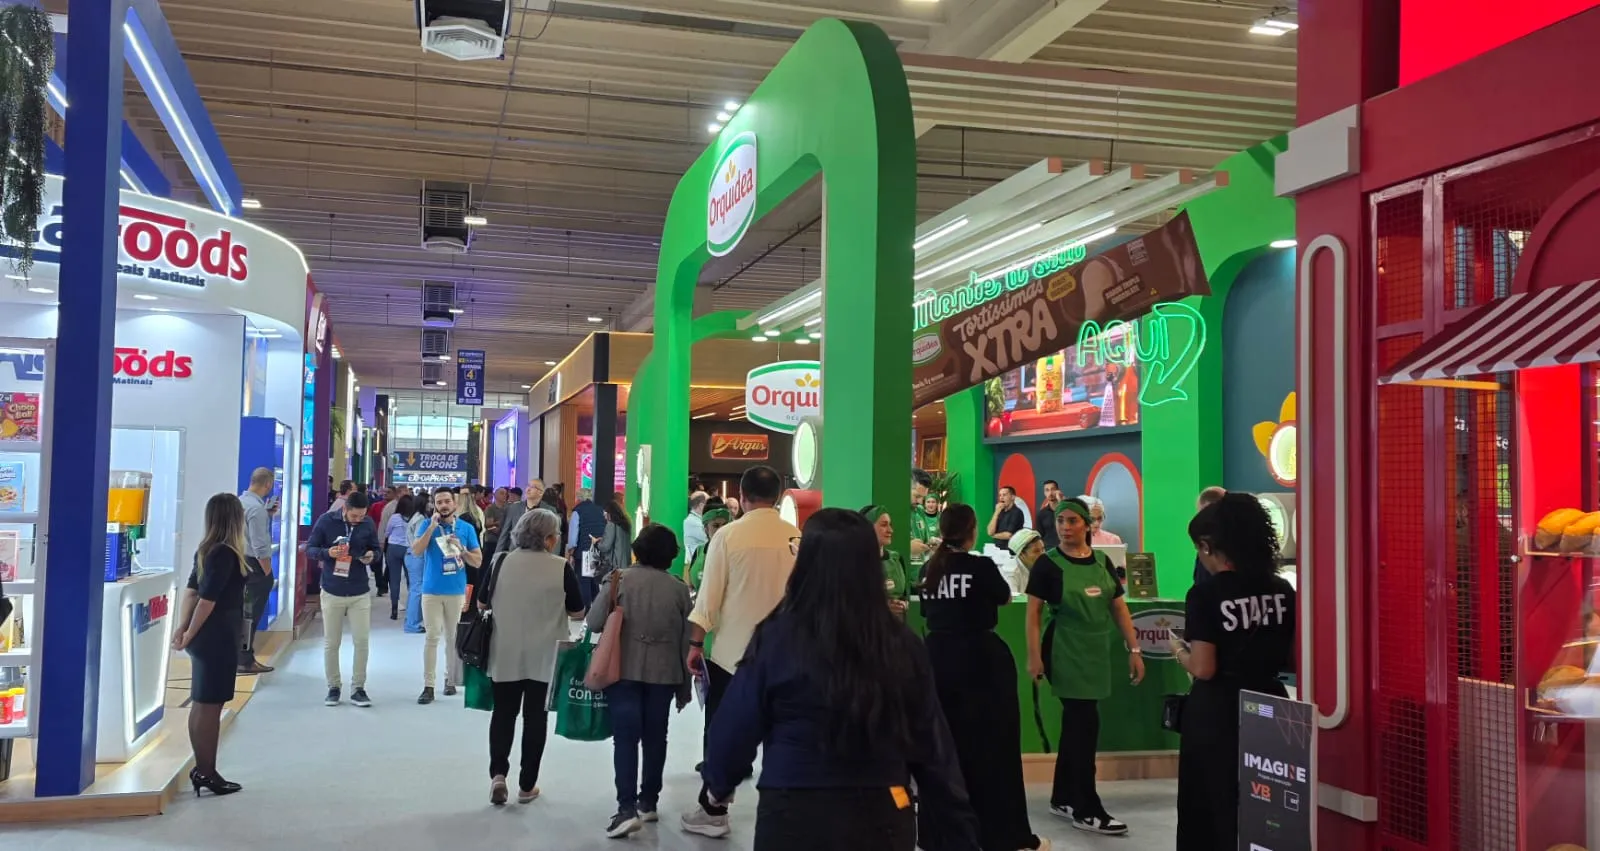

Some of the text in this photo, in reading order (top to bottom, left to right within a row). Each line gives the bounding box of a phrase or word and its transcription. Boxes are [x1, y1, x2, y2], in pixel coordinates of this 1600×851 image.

[148, 267, 205, 287] Matinais
[963, 298, 1058, 383] XTRA
[1076, 317, 1169, 367] AQUI
[466, 370, 474, 380] 4
[467, 387, 474, 397] Q
[420, 461, 458, 469] CUPONS
[922, 574, 973, 599] AFF
[1221, 594, 1287, 632] STAFF
[1244, 752, 1307, 783] IMAGINE
[1251, 781, 1272, 798] VB
